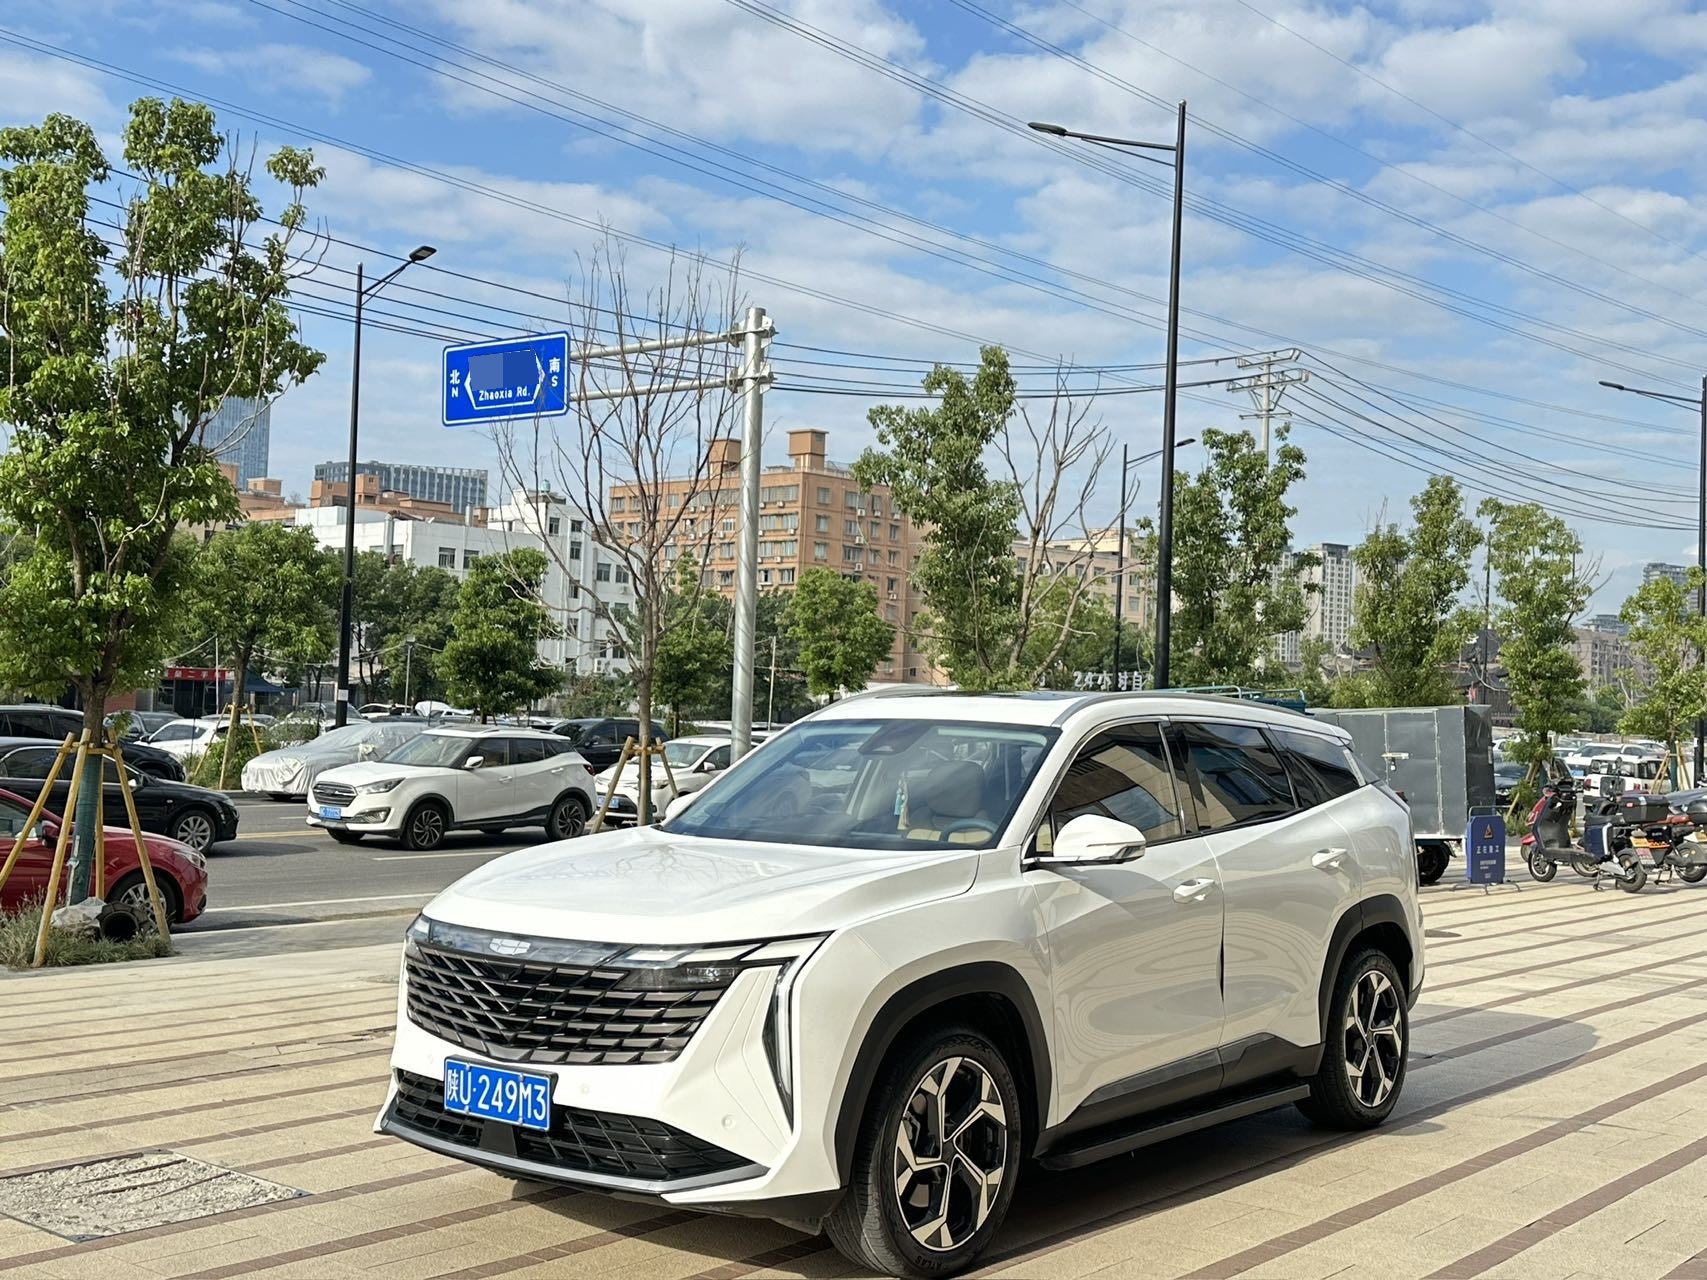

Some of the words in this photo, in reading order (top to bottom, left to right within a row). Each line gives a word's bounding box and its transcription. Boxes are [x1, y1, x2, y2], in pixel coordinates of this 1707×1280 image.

[549, 357, 561, 373] 南
[450, 369, 461, 385] 北
[551, 375, 558, 387] S
[451, 387, 459, 398] N
[478, 388, 513, 402] Zhaoxia
[516, 386, 531, 398] Rd.
